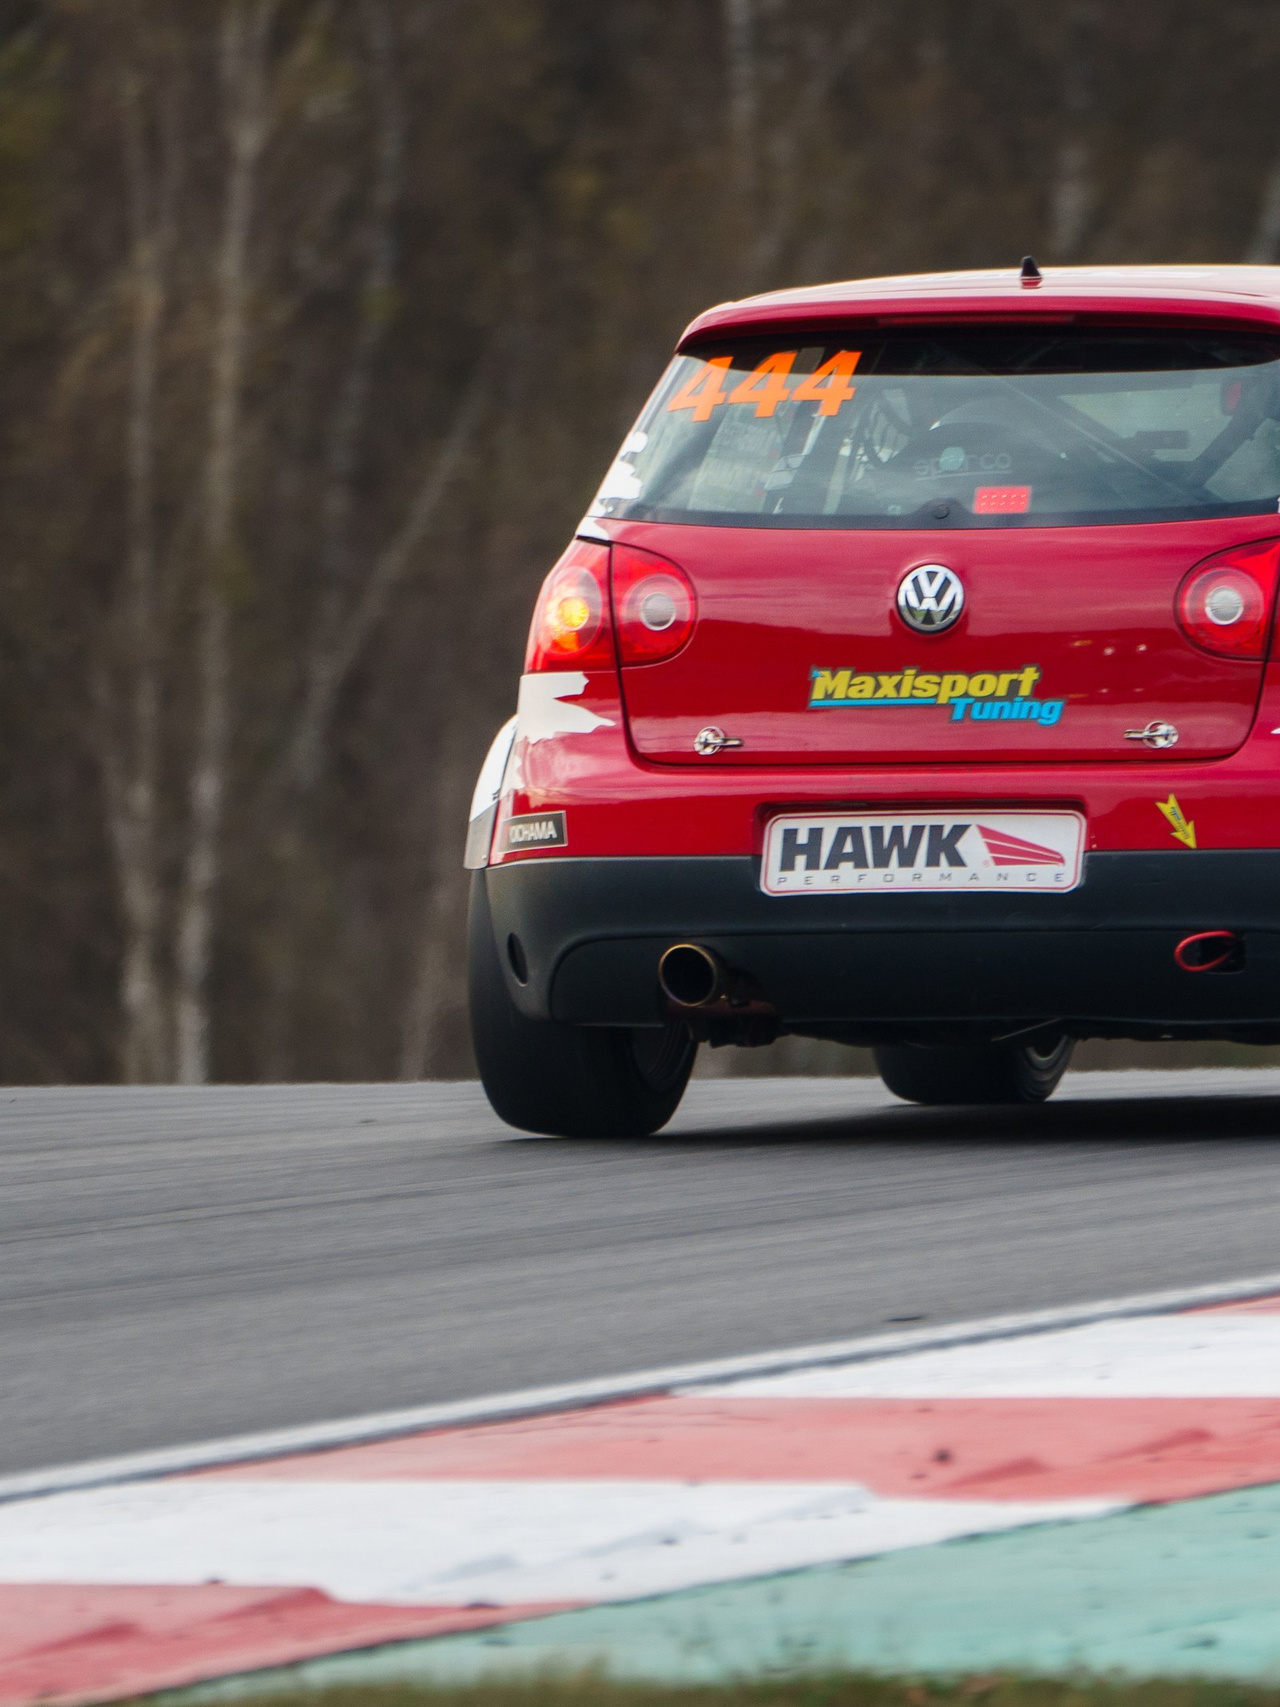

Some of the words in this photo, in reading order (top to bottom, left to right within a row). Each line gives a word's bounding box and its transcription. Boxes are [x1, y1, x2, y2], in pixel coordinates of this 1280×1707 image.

[667, 350, 863, 423] 444
[810, 666, 1041, 704] Maxisport
[950, 697, 1064, 725] Tuning
[779, 823, 973, 872] HAWK
[776, 871, 1066, 886] PERFORMANCE
